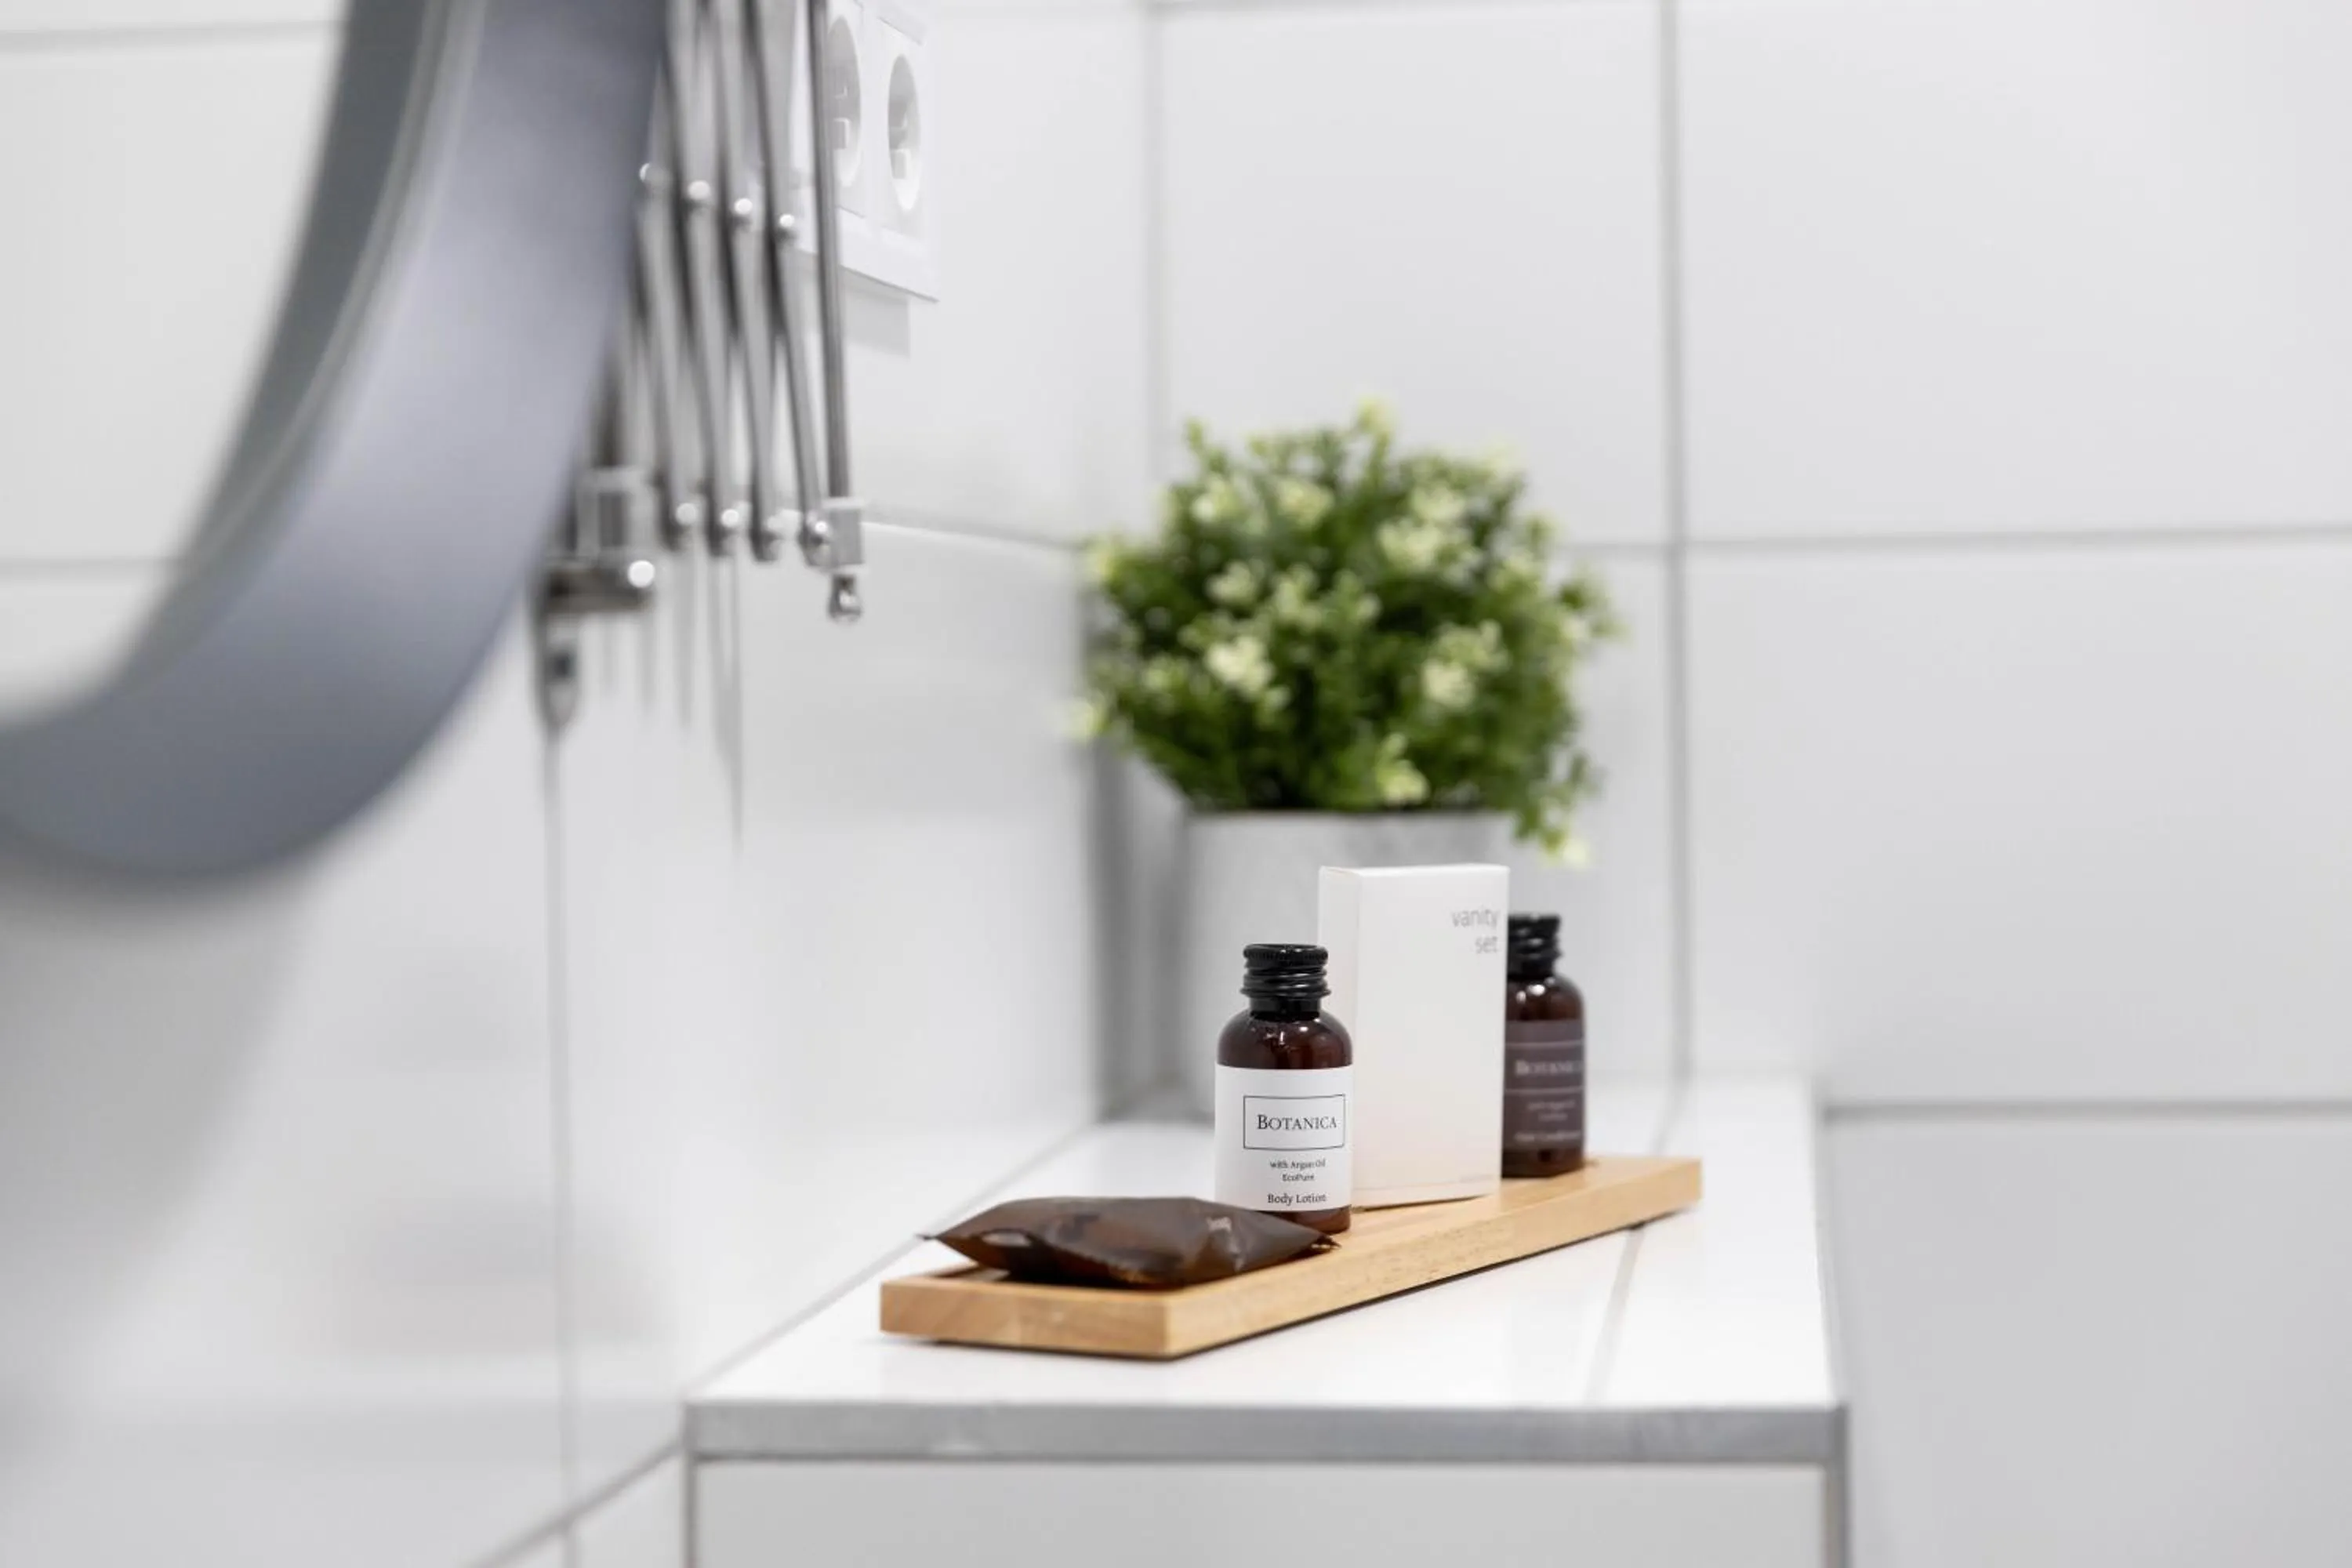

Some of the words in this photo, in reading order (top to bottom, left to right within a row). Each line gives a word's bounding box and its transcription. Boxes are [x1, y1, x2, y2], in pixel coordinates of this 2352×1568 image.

[1450, 906, 1500, 932] vanity
[1474, 935, 1497, 953] set
[1257, 1114, 1337, 1131] BOTANICA
[1269, 1160, 1288, 1168] with
[1290, 1160, 1314, 1171] Argan
[1315, 1157, 1326, 1167] Oil
[1267, 1192, 1293, 1207] Body
[1296, 1192, 1327, 1203] Lotion
